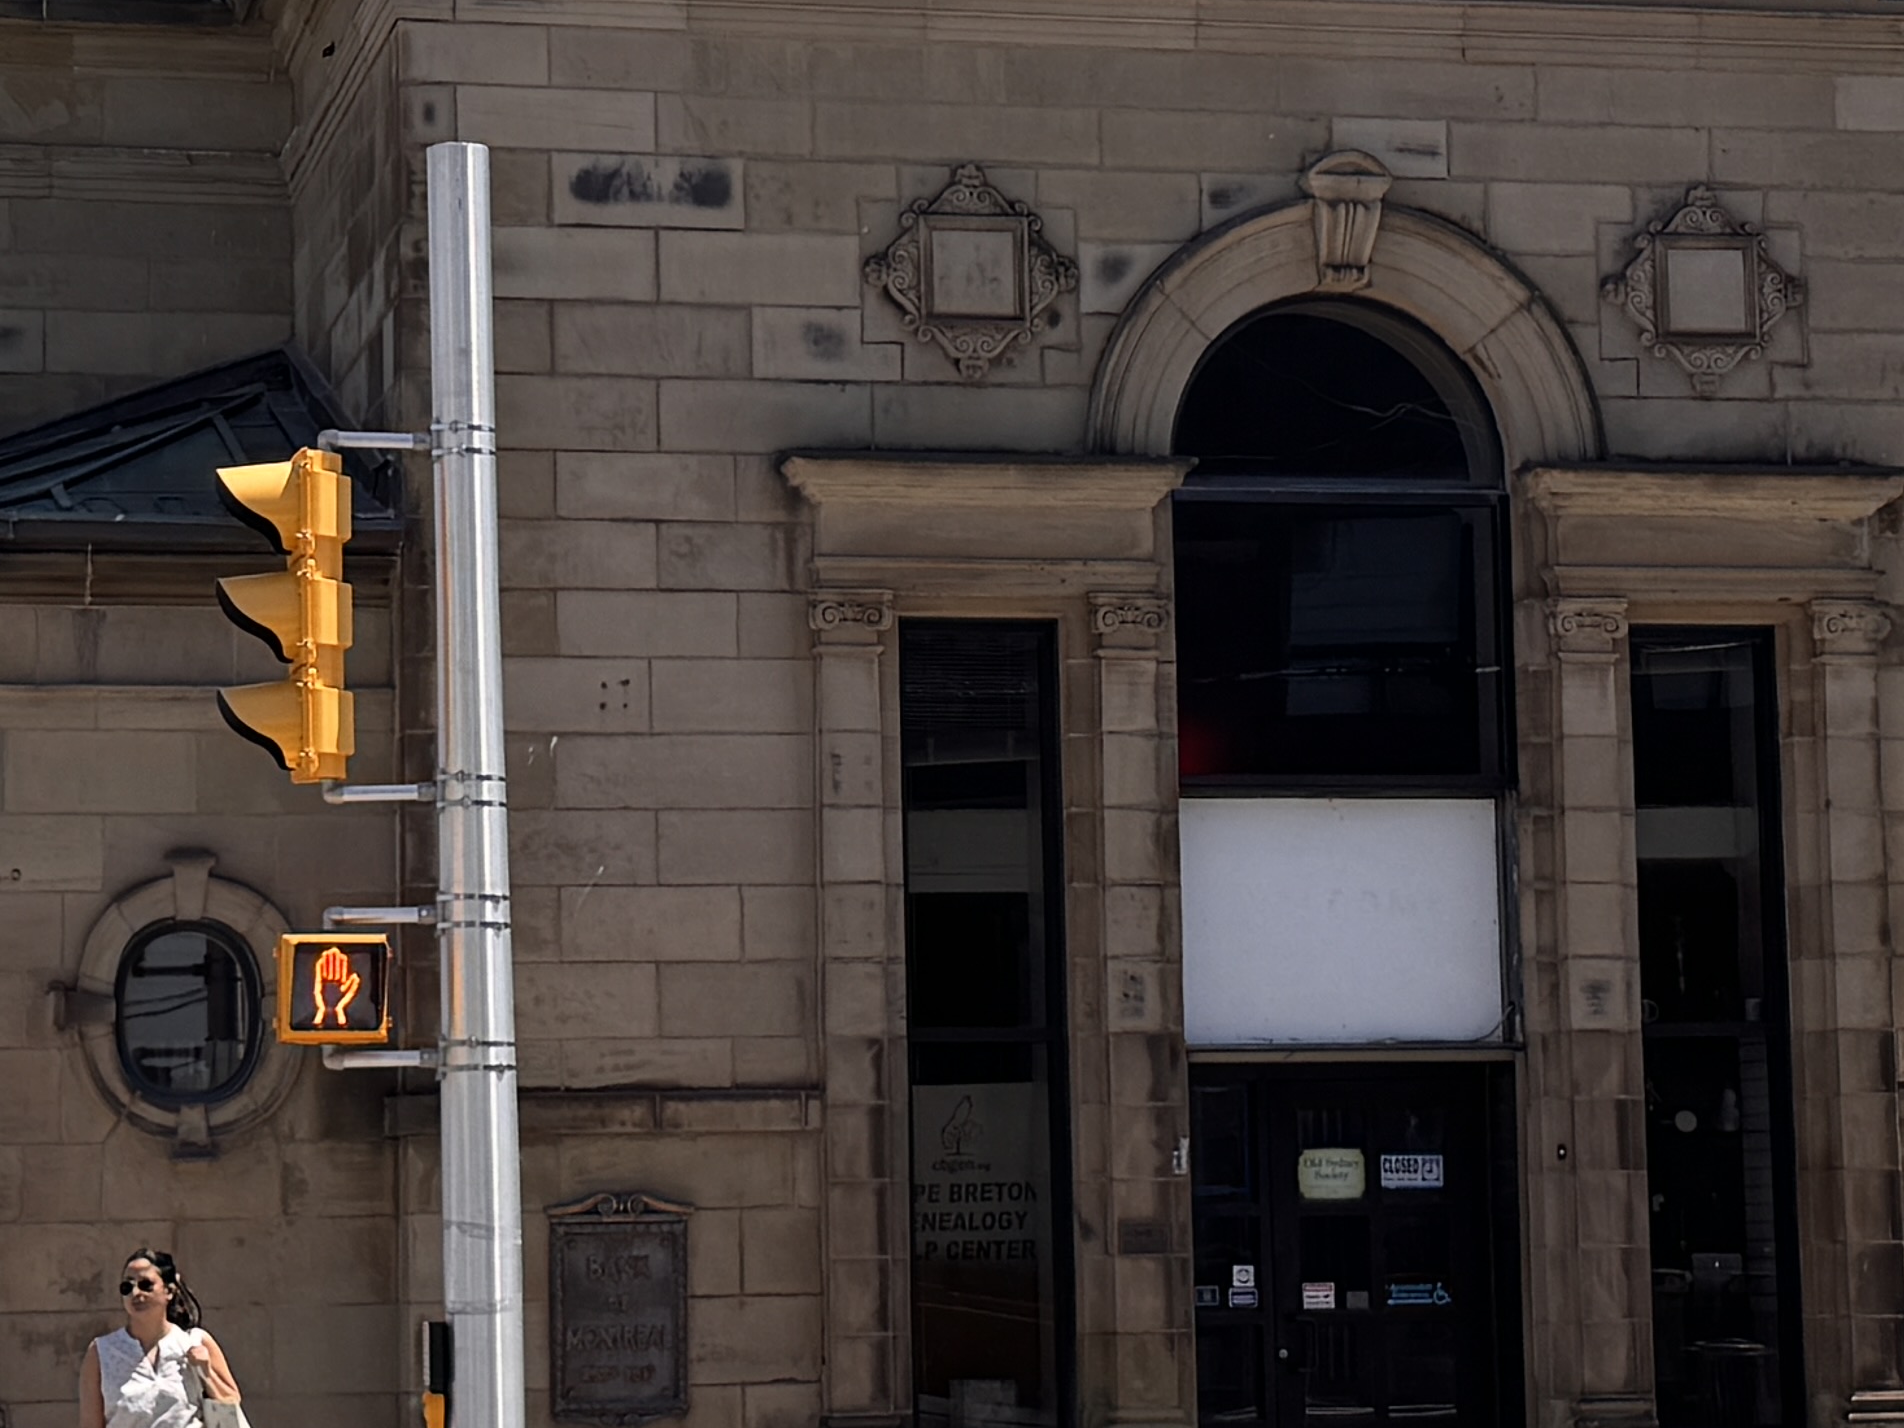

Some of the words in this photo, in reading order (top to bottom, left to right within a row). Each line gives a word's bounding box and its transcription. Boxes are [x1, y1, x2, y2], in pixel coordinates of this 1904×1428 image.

[1383, 1157, 1420, 1174] CLOSED
[949, 1182, 1037, 1203] BRETON
[946, 1240, 1036, 1261] CENTER
[566, 1323, 666, 1353] MONTREAL
